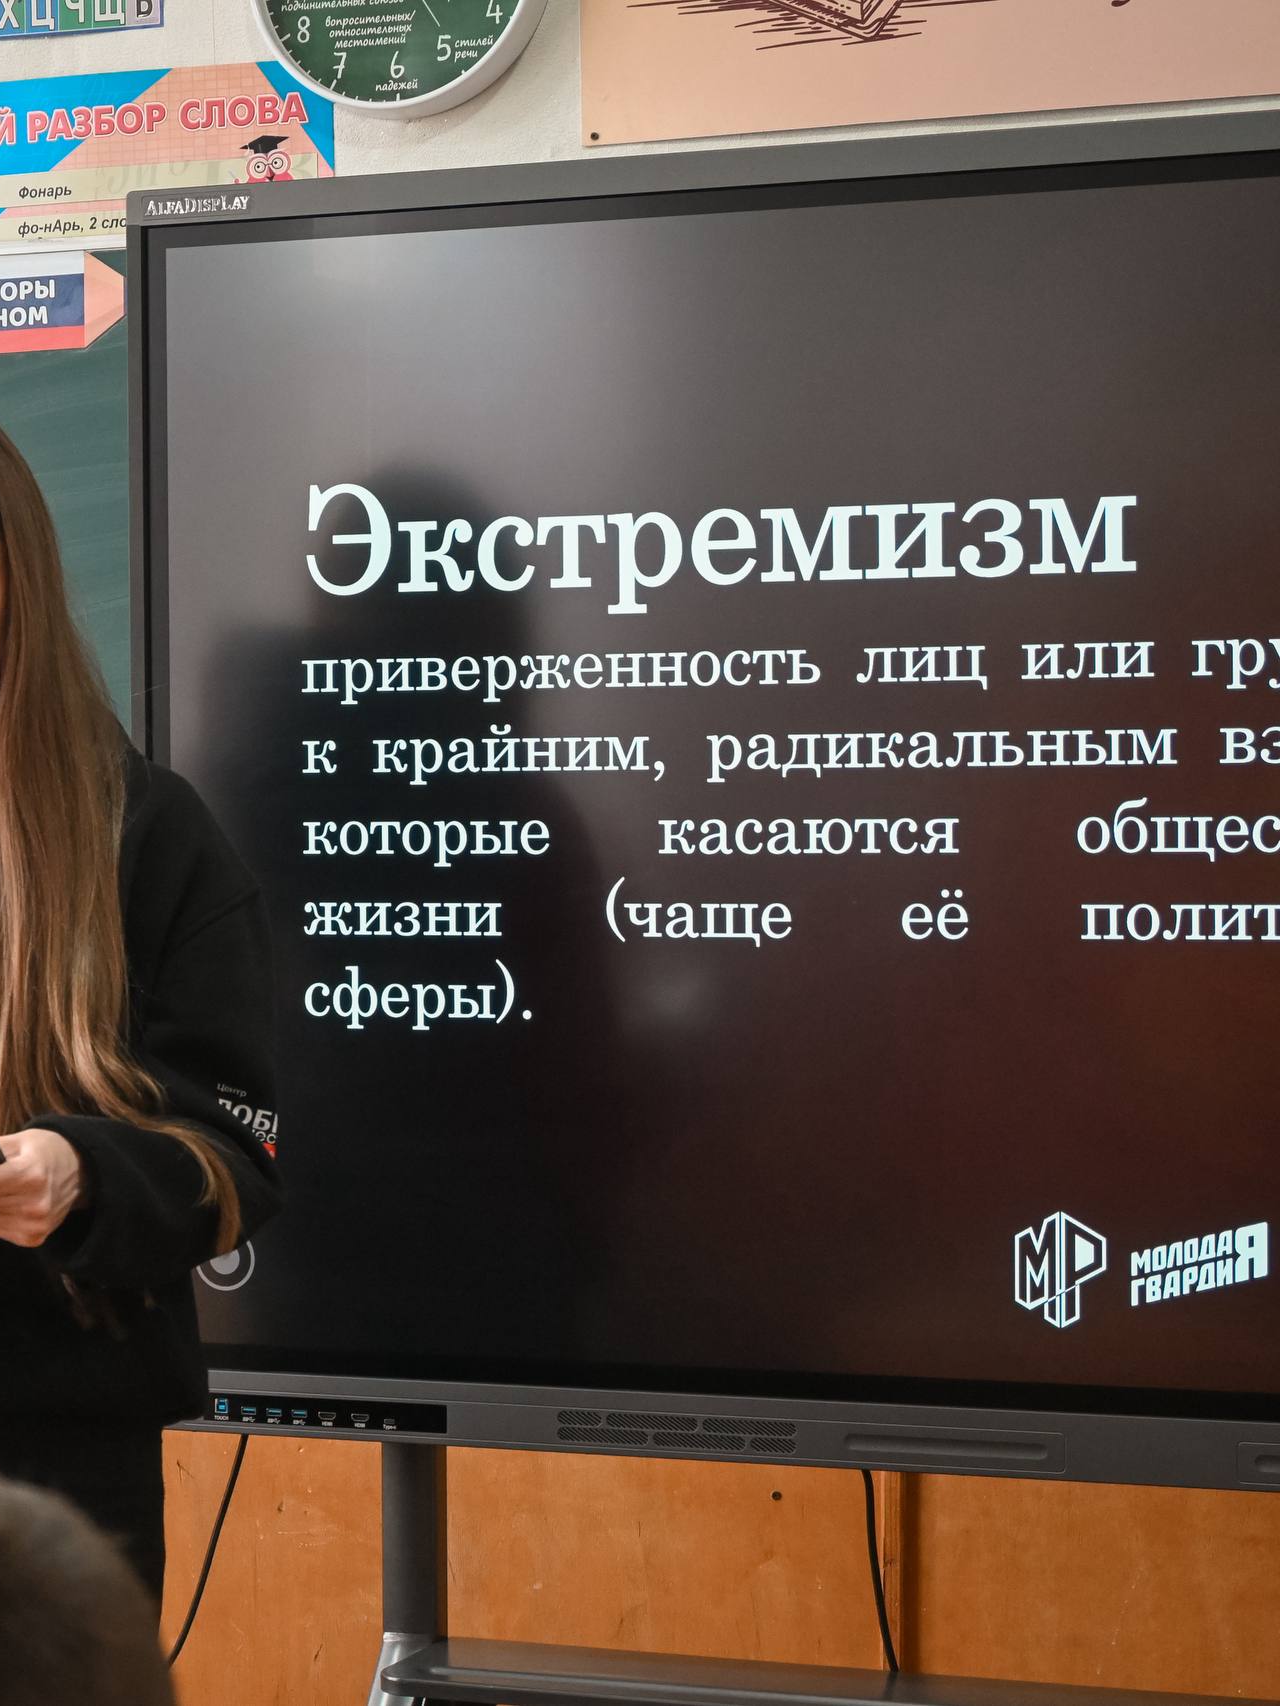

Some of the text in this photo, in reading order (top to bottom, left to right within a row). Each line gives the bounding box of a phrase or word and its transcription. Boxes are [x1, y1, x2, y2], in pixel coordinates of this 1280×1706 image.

[325, 10, 416, 29] вопросительных/
[486, 0, 503, 24] 4
[297, 16, 310, 43] 8
[329, 24, 412, 38] относительных
[334, 35, 407, 49] местоимений
[437, 34, 493, 62] 5 стилей
[454, 50, 478, 62] речи
[333, 52, 346, 79] 7
[390, 51, 404, 79] 6
[375, 79, 418, 92] падежей
[27, 102, 167, 143] РАЗБОР
[178, 91, 309, 131] СЛОВА
[18, 184, 72, 200] Фонарь
[18, 219, 84, 238] фо-нАрь,
[89, 216, 98, 230] 2
[306, 483, 1137, 614] Экстремизм
[302, 649, 821, 705] приверженность
[856, 645, 988, 690] лиц
[1022, 641, 1155, 680] или
[302, 740, 337, 774] к
[372, 724, 665, 786] крайним,
[707, 728, 1178, 783] радикальным
[302, 797, 1280, 868] которые касаются общес
[303, 876, 1280, 948] жизни (чаще её полит
[304, 959, 532, 1031] сферы).
